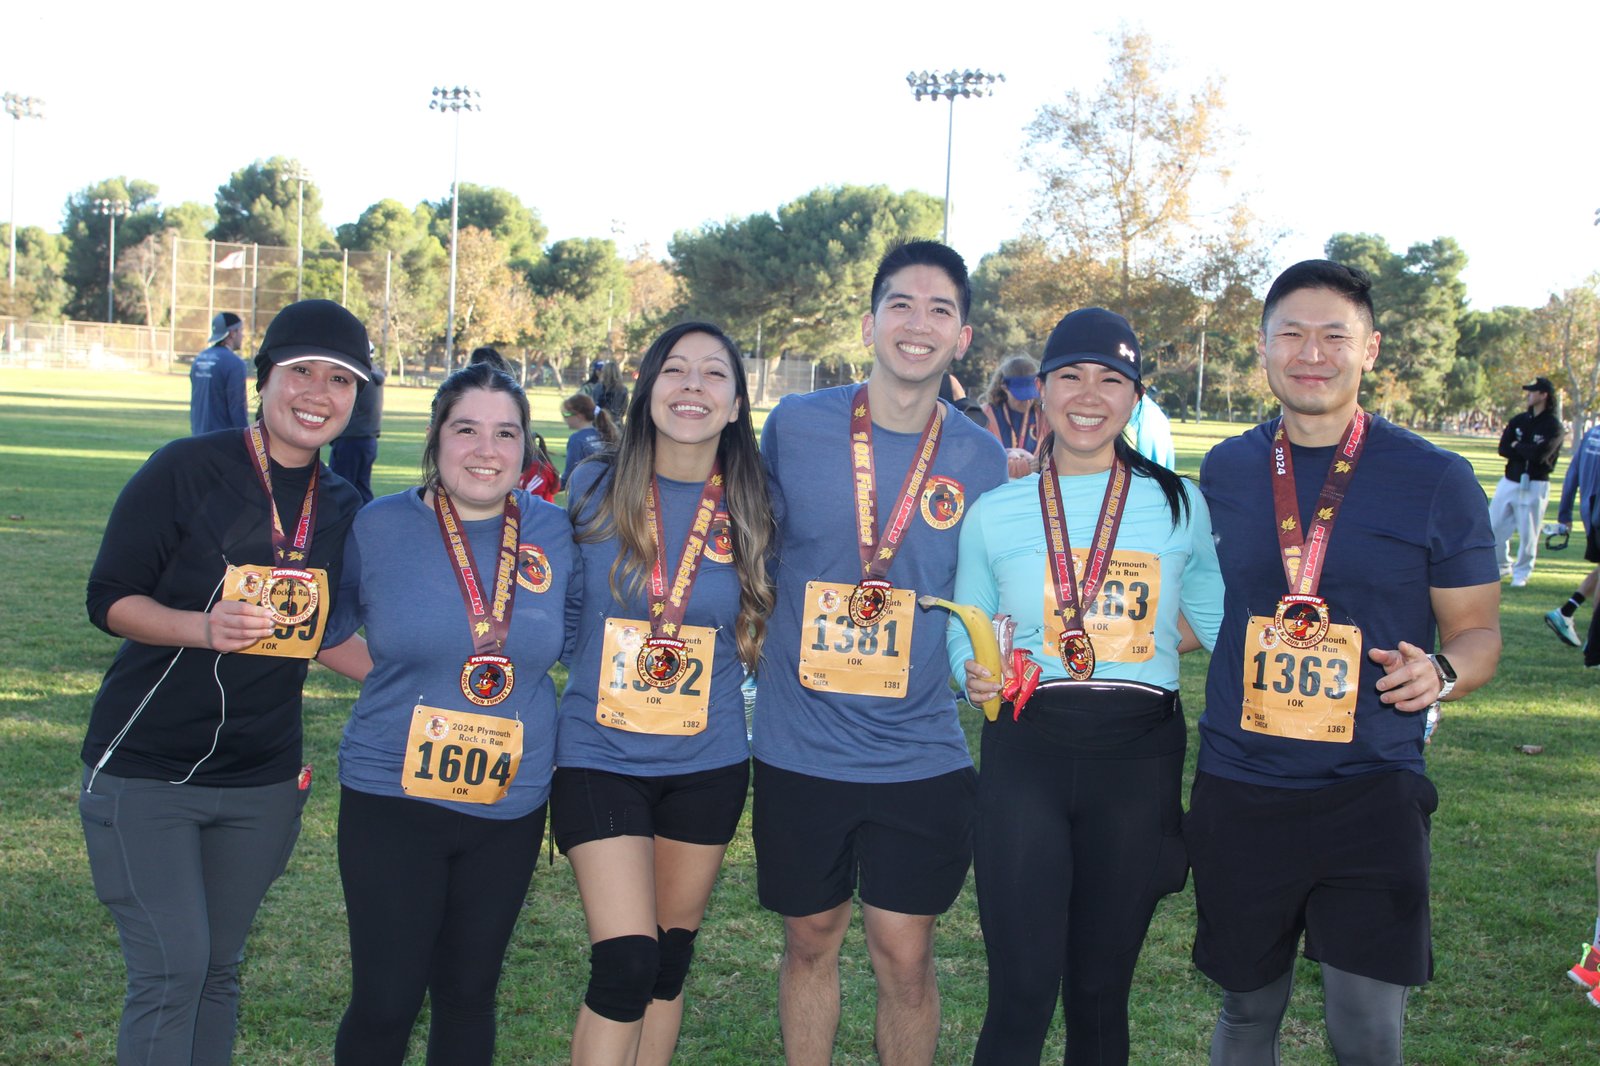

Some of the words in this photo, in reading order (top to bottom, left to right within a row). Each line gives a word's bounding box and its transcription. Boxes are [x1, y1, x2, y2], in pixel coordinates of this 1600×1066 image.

[853, 431, 871, 470] 10K
[1275, 447, 1286, 475] 2024
[888, 494, 915, 544] PLYMOUTH
[907, 468, 925, 498] ROCK
[921, 438, 936, 462] RUN
[856, 472, 875, 547] Finisher
[1046, 498, 1060, 518] RUN
[443, 512, 458, 534] RUN
[692, 498, 716, 537] 10K
[502, 515, 518, 553] 10K
[1051, 527, 1065, 553] ROCK
[1083, 547, 1106, 597] PLYMOUTH
[1097, 524, 1113, 551] ROCK
[1106, 495, 1120, 517] RUN
[1303, 524, 1326, 579] PLYMOUTH
[453, 542, 471, 569] ROCK
[669, 534, 704, 608] Finisher
[1110, 560, 1148, 569] Plymouth
[1054, 552, 1073, 602] PLYMOUTH
[1299, 576, 1313, 595] RO
[491, 550, 516, 624] Finisher
[1284, 595, 1323, 604] PLYMOUTH
[811, 613, 899, 657] 1381
[1092, 623, 1109, 631] 10K
[261, 642, 278, 650] 10K
[649, 639, 684, 648] PLYMOUTH
[1285, 637, 1300, 647] RUN
[1301, 633, 1323, 647] TURKEY
[1323, 637, 1347, 645] mouth
[1322, 645, 1338, 653] Run
[471, 655, 508, 664] PLYMOUTH
[847, 658, 863, 666] 10K
[660, 673, 682, 686] TURKEY
[1252, 650, 1348, 700] 1363
[884, 681, 900, 690] 1381
[471, 696, 486, 705] RUN
[645, 696, 662, 705] 10K
[1287, 698, 1304, 708] 10K
[452, 722, 475, 733] 2024
[477, 726, 512, 739] Plymouth
[682, 720, 701, 729] 1382
[1327, 724, 1346, 733] 1363
[458, 733, 479, 743] Rock
[489, 737, 505, 747] Run
[414, 740, 512, 788] 1604
[452, 786, 470, 796] 10K
